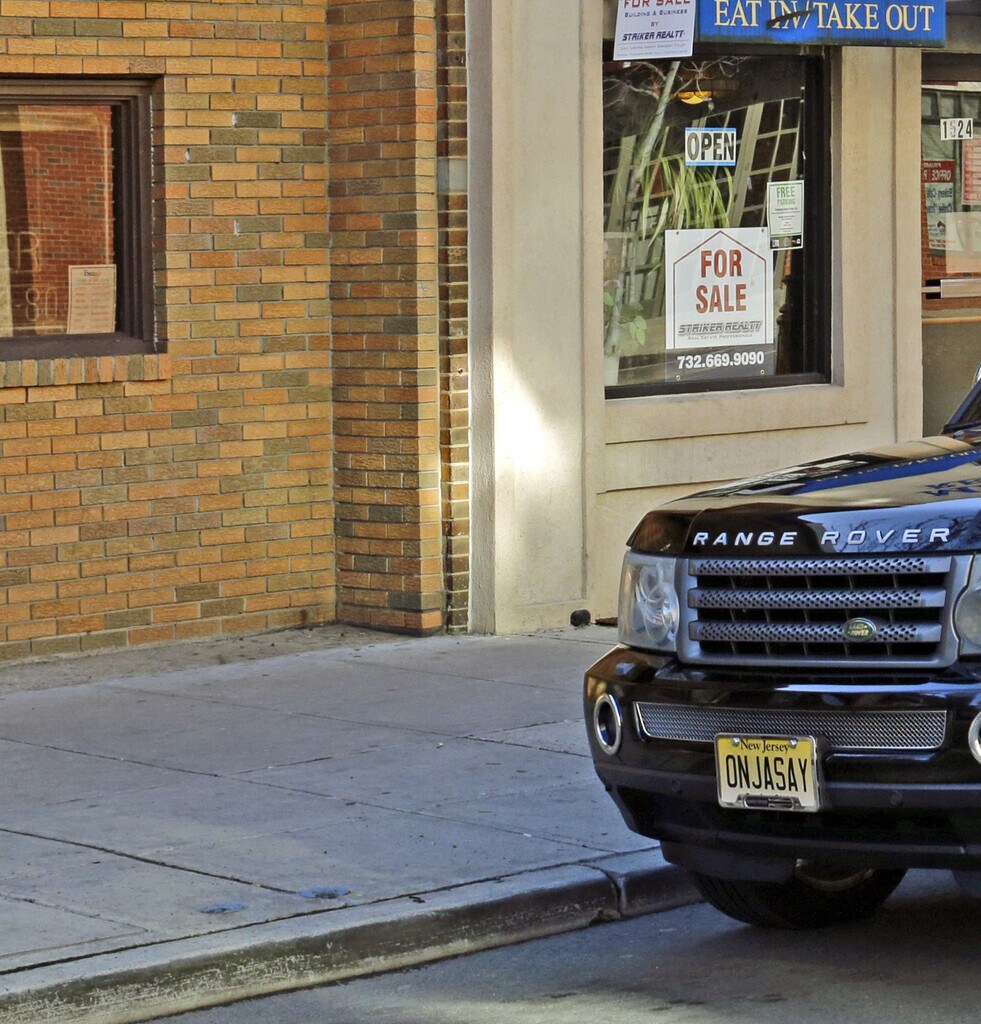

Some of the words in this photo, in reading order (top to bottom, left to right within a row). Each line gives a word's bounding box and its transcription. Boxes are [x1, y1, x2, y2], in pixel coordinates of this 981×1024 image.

[714, 0, 762, 26] EAT
[885, 4, 935, 31] OUT
[622, 31, 656, 41] STRIKER
[687, 132, 735, 161] OPEN
[776, 186, 796, 198] FREE
[701, 249, 743, 278] FOR
[696, 284, 747, 314] SALE
[678, 322, 723, 335] STRIKER
[677, 351, 765, 370] 732.669.9090
[692, 531, 798, 546] RANGE
[821, 527, 951, 545] ROVER
[740, 738, 760, 751] New
[762, 739, 790, 754] Jersey
[725, 754, 808, 793] ONJASAY
